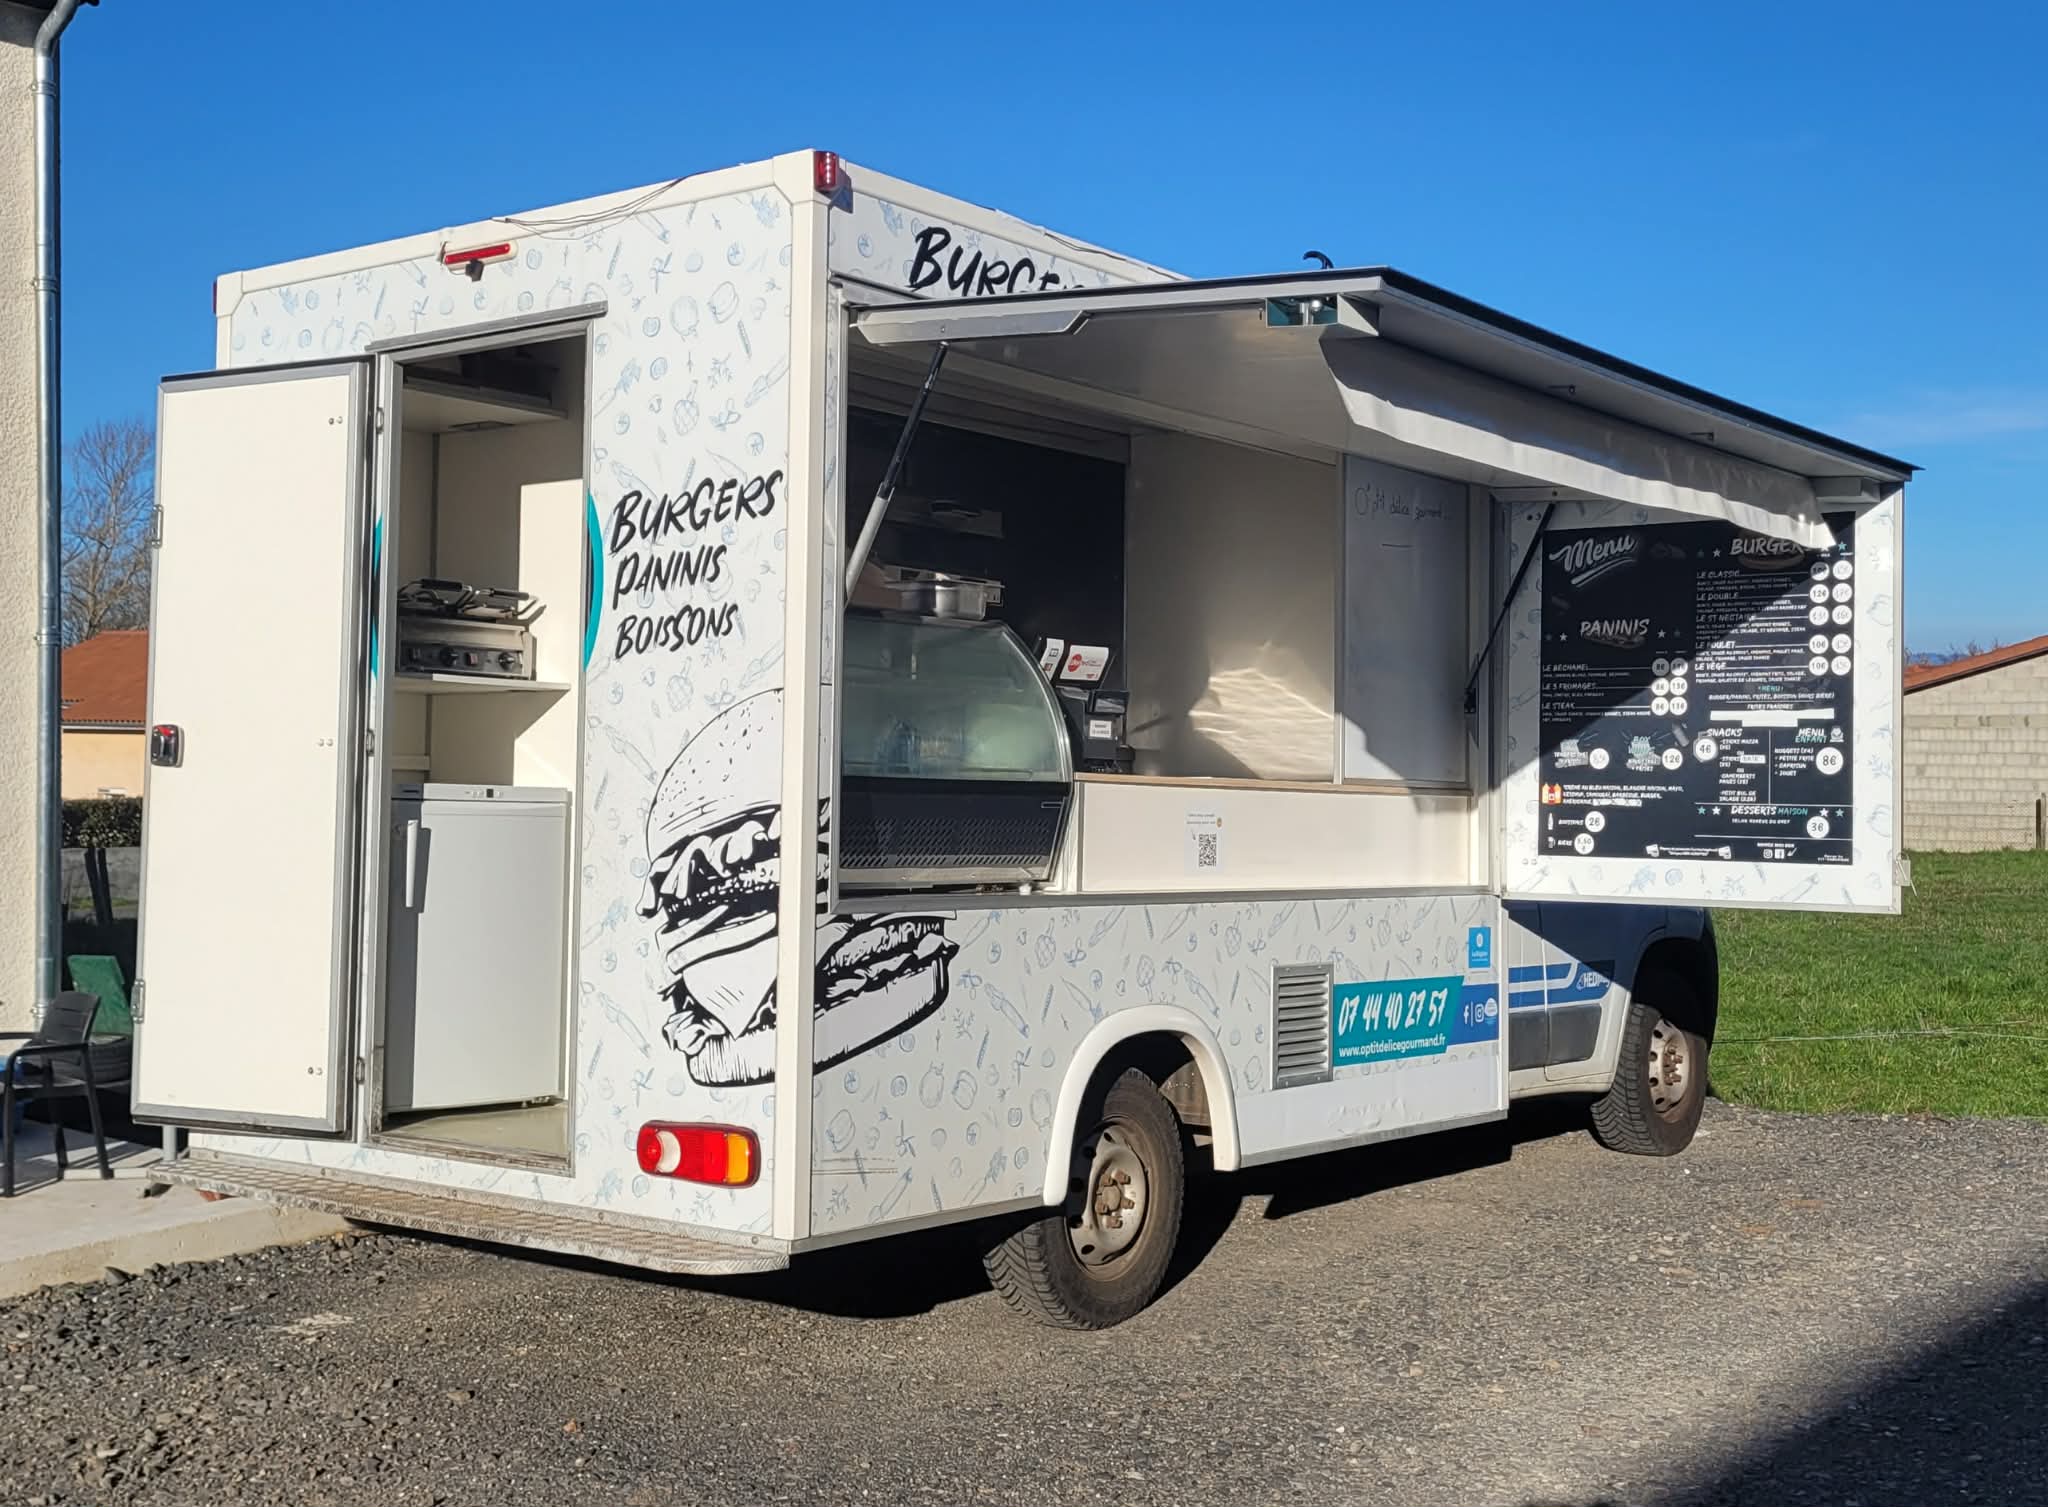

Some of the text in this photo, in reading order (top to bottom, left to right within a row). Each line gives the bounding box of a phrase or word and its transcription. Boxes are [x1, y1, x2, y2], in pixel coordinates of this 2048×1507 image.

[609, 469, 784, 558] BURGERS
[1548, 534, 1640, 573] Menu
[612, 543, 728, 611] PANINIS
[1707, 592, 1739, 601] DOUBLE
[615, 601, 739, 660] BOISSONS
[1579, 617, 1651, 636] PANINIS
[1694, 663, 1706, 671] LE
[1706, 728, 1743, 737] SNACKS
[1794, 735, 1828, 744] ENFANT
[1798, 727, 1826, 737] MENU
[1822, 754, 1837, 767] 8€
[1730, 805, 1809, 817] DESSERTS MAISON
[1338, 987, 1448, 1037] 07 44 40 27 57
[1338, 1033, 1446, 1058] www.optitdelicegourmand.fr
